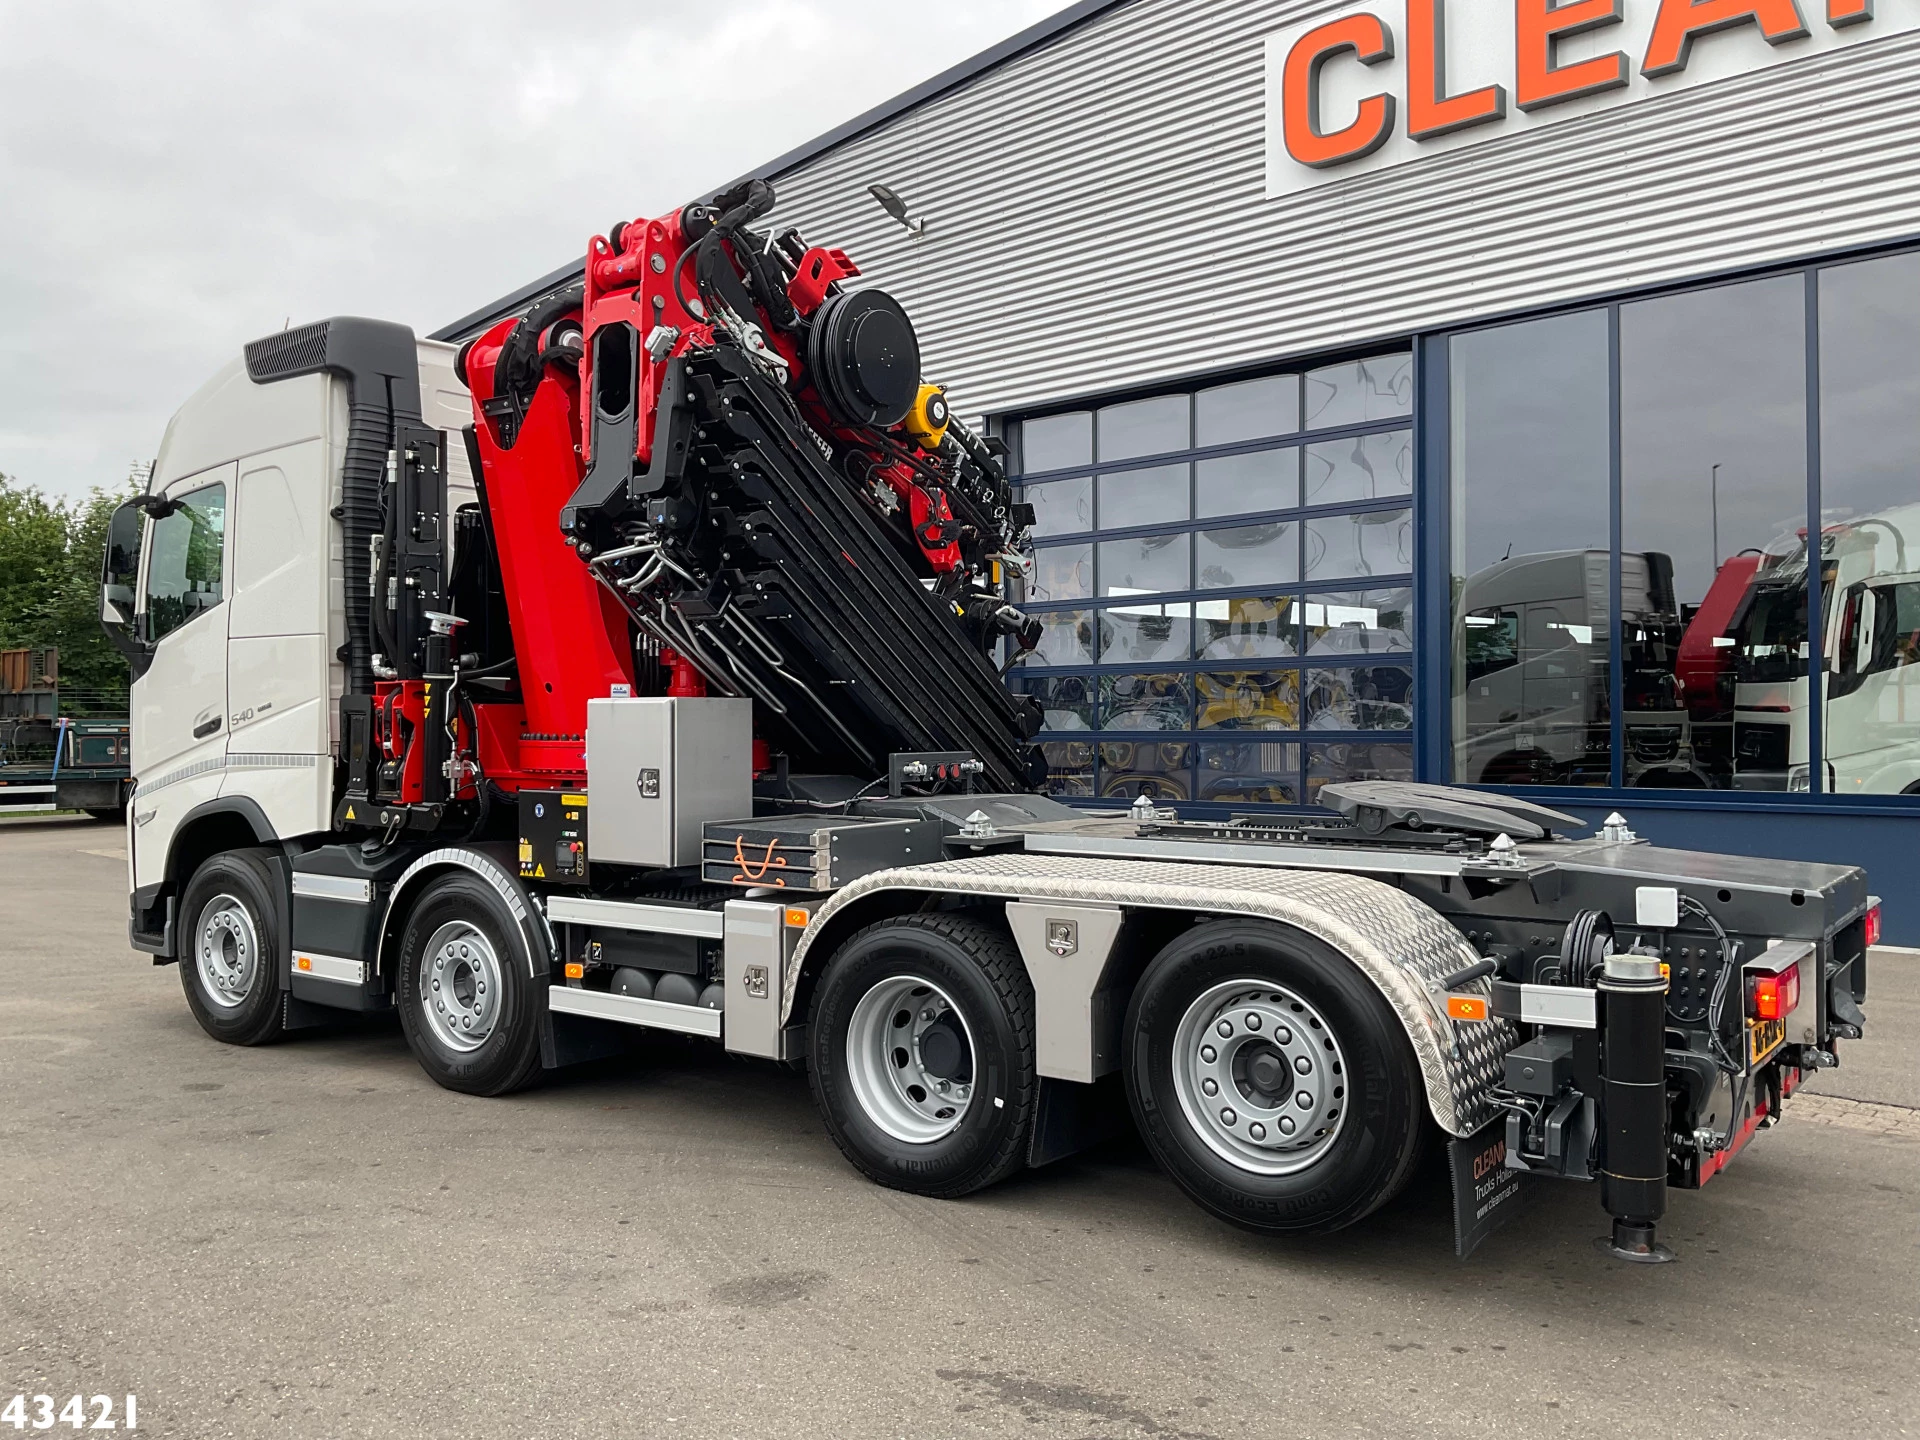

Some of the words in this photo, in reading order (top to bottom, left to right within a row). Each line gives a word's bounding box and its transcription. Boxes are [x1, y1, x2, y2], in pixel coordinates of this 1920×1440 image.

[231, 707, 254, 726] 540
[1205, 940, 1246, 965] 22.5
[400, 952, 413, 998] Hybrid
[1475, 1177, 1496, 1202] Trucks
